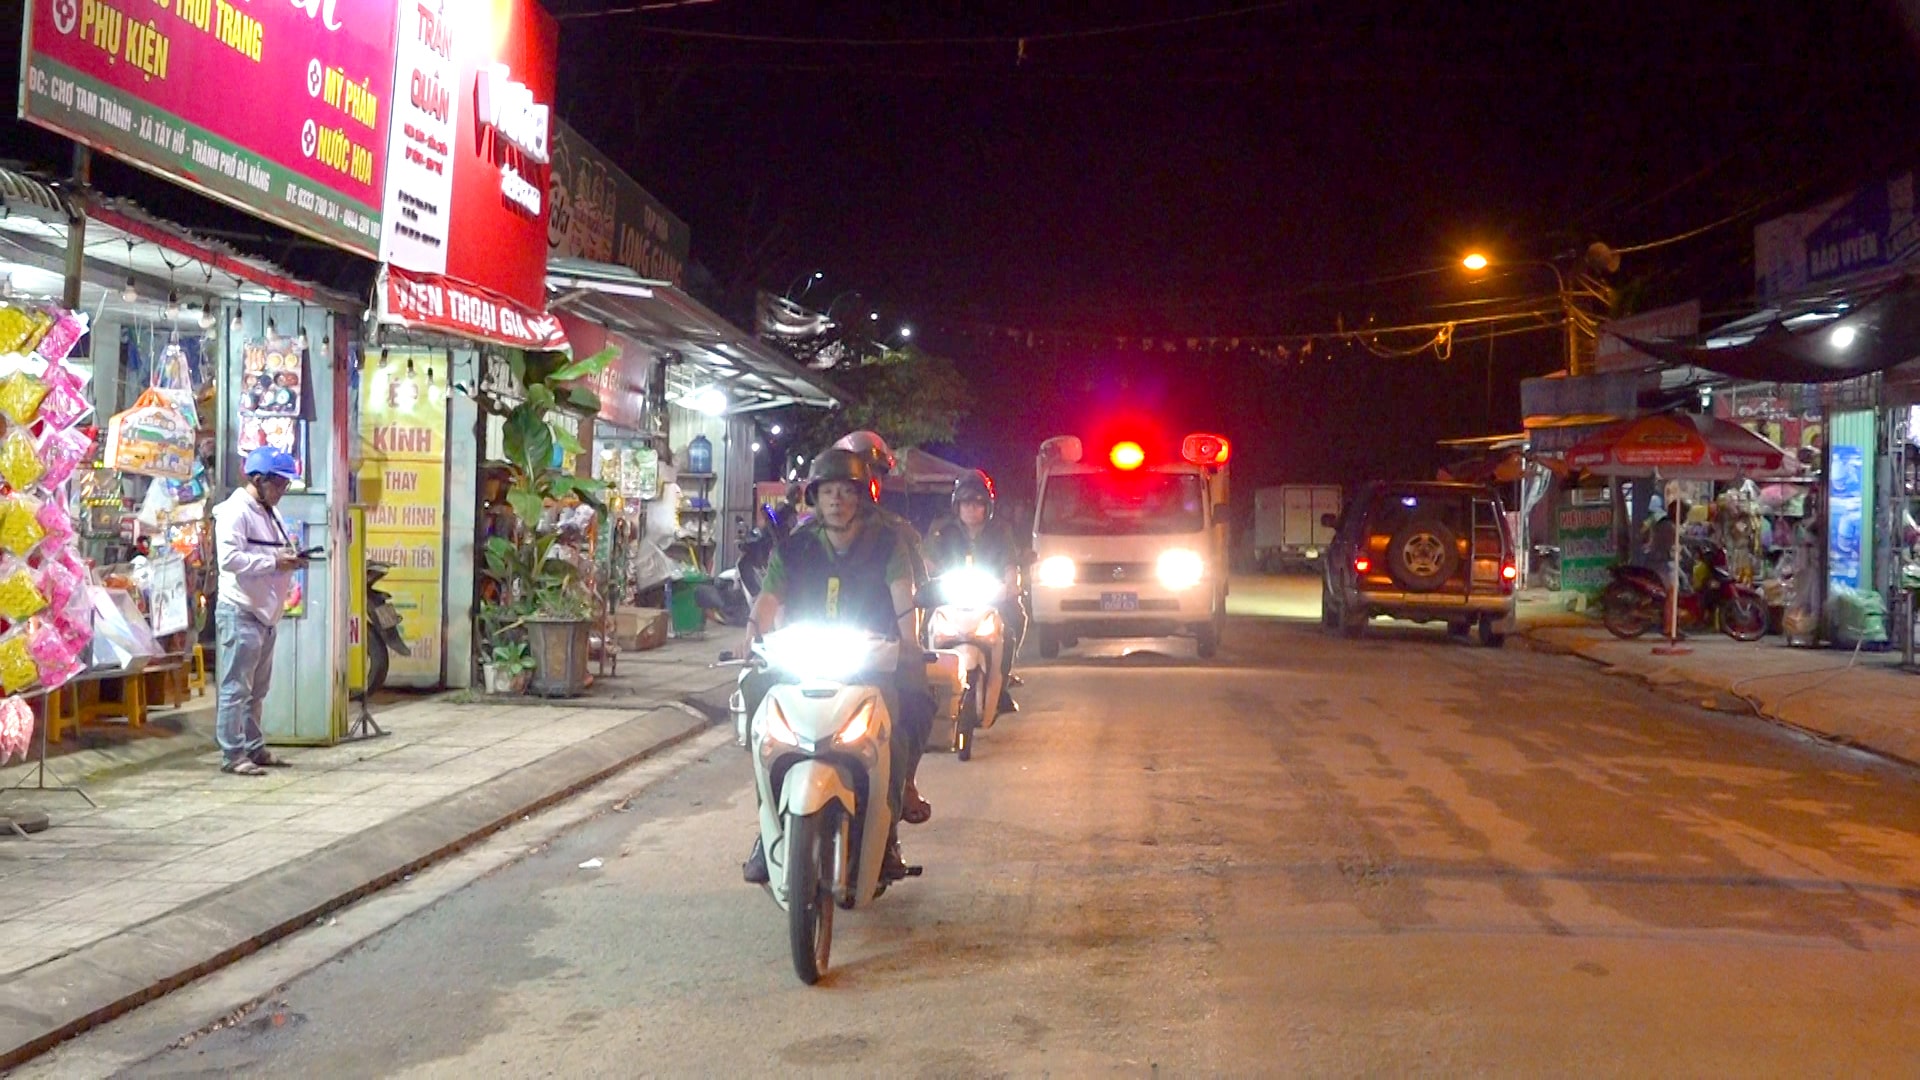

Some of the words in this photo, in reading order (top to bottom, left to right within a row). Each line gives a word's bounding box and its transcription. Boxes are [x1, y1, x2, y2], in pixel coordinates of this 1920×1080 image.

[80, 0, 122, 64] PHỤ
[125, 19, 169, 82] KIỆN
[216, 0, 264, 63] TRANG
[323, 66, 344, 110] MỸ
[344, 77, 377, 130] PHẨM
[411, 68, 449, 125] QUÂN
[51, 76, 74, 111] CHỢ
[76, 86, 98, 118] TAM
[154, 121, 172, 149] TÂY
[219, 151, 238, 178] PHỐ
[316, 125, 350, 174] NƯỚC
[350, 143, 373, 186] HOA
[447, 288, 498, 336] THOẠI
[373, 421, 432, 452] KÍNH
[385, 471, 418, 491] THAY
[402, 503, 436, 526] HÌNH
